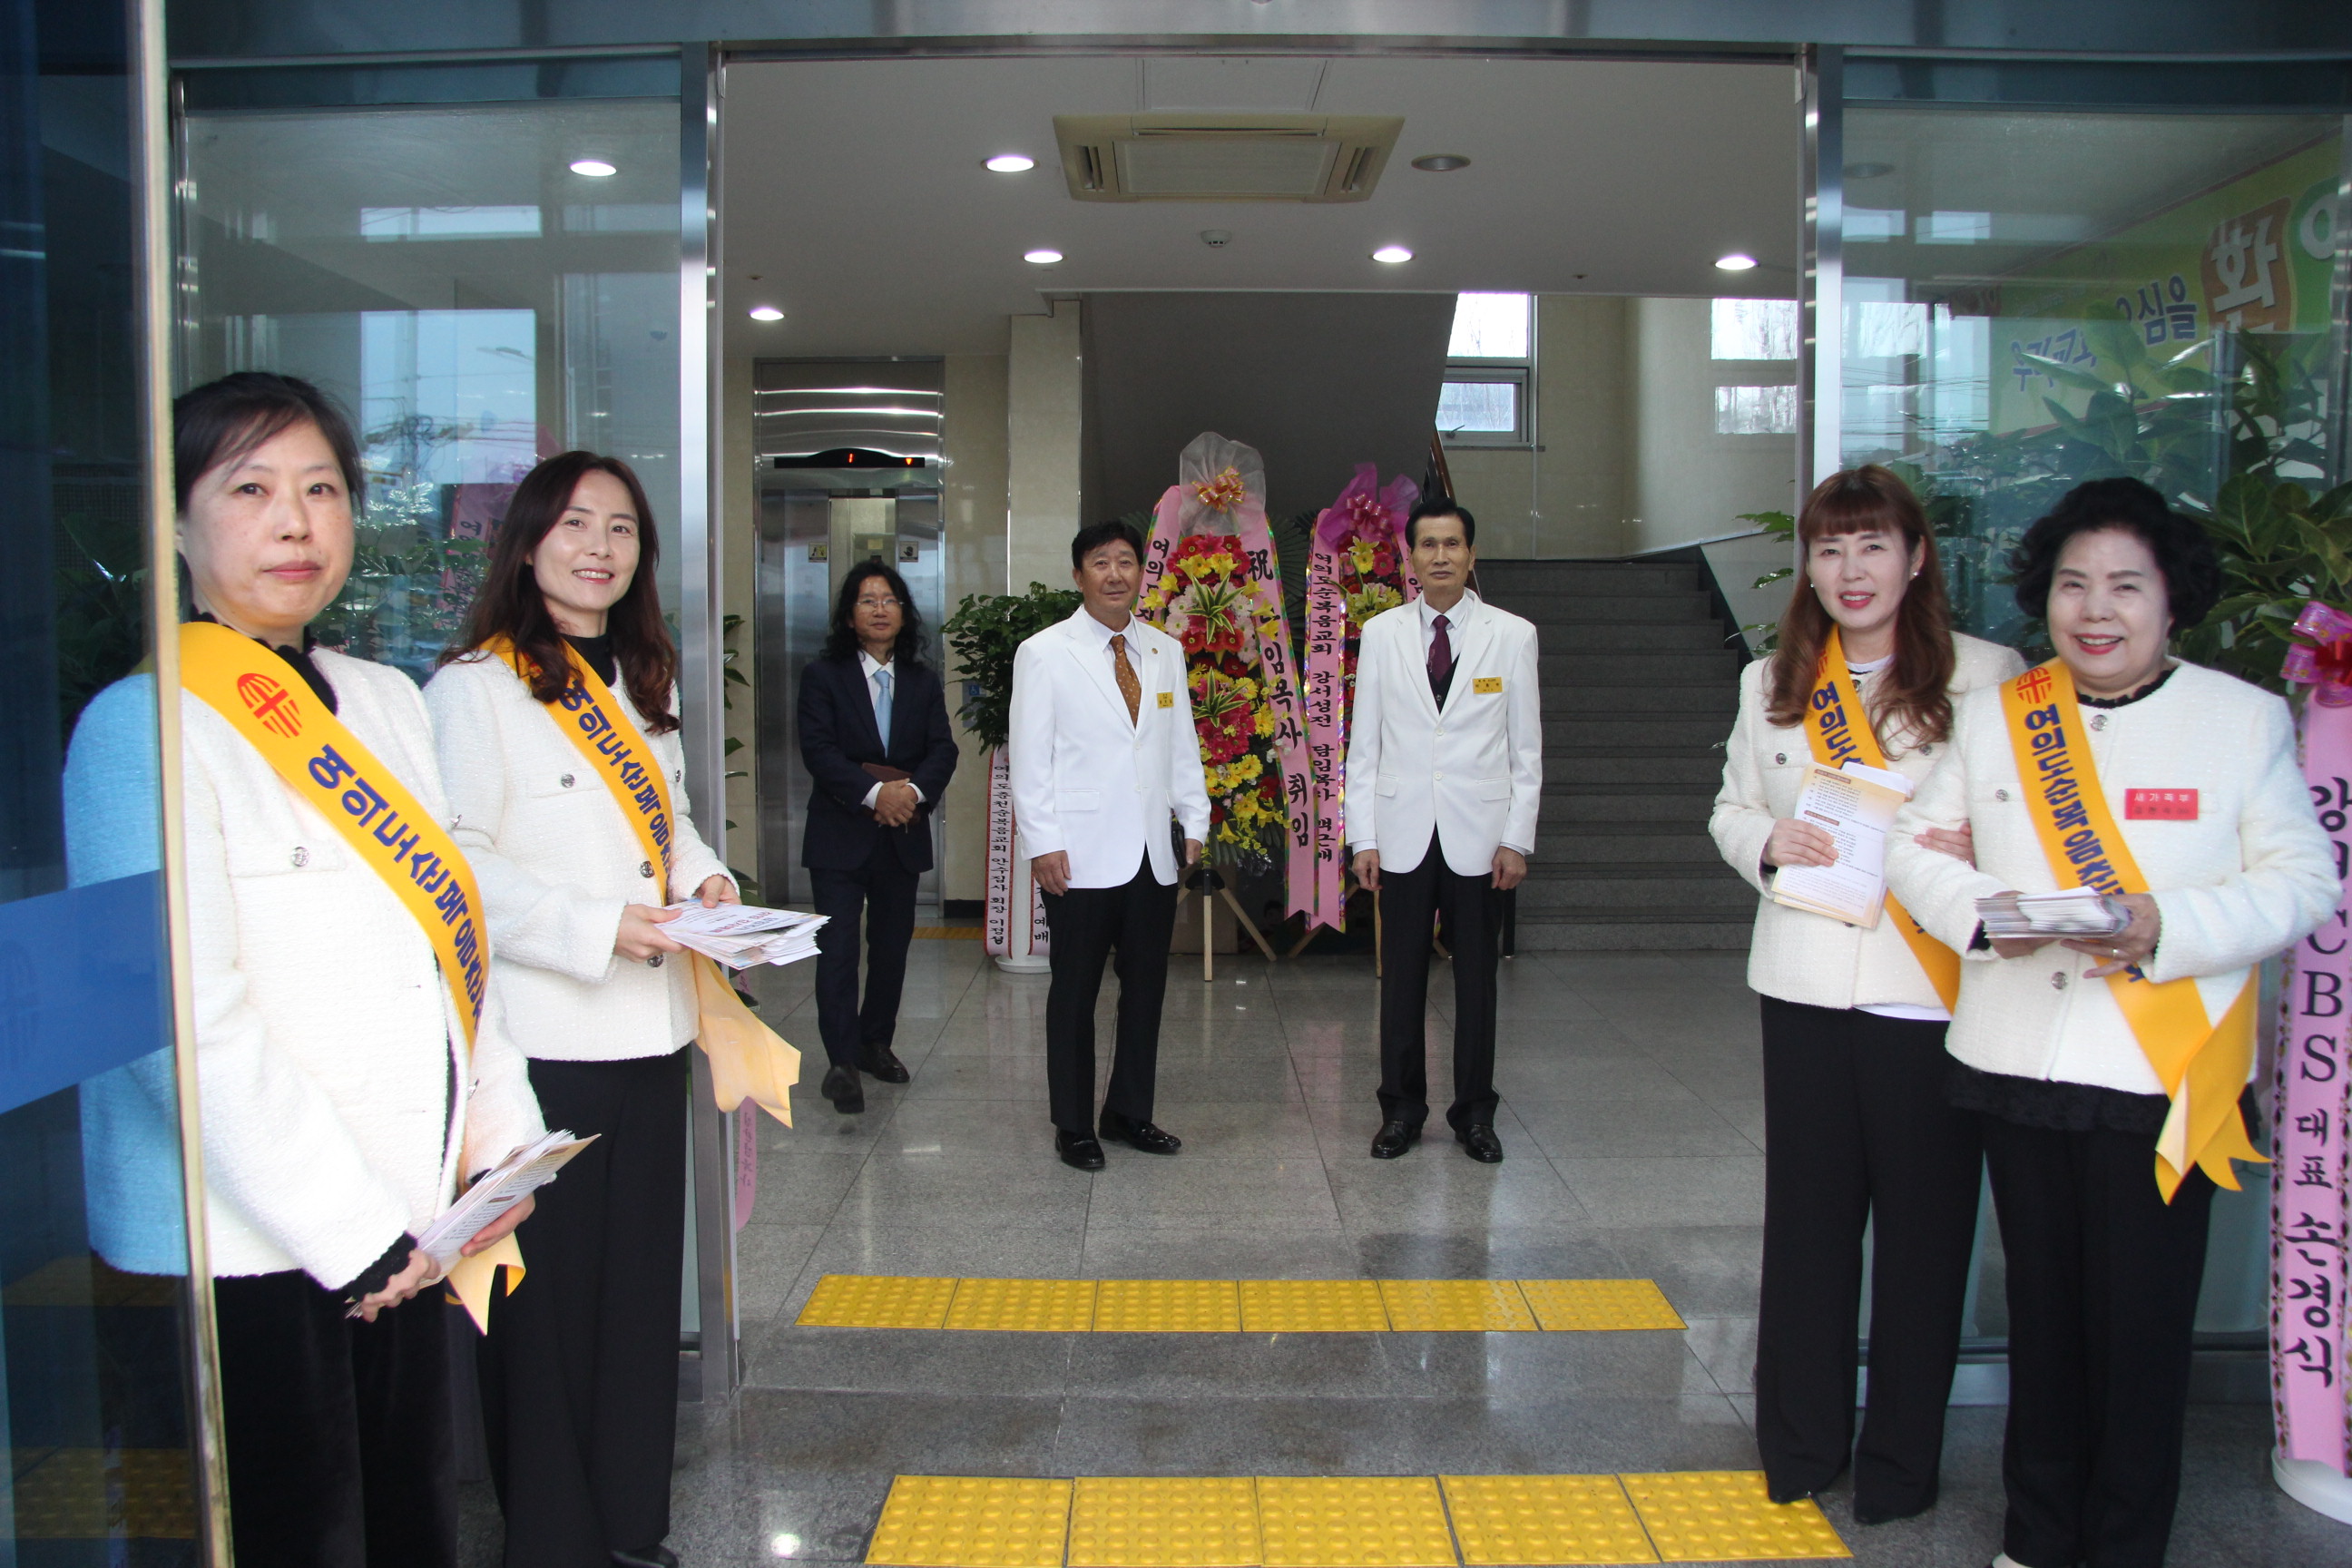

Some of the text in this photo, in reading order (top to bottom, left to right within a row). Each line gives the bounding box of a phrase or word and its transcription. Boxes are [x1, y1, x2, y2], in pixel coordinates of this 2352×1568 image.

[1310, 554, 1338, 655] 여의도순복음교회
[1247, 549, 1273, 582] 祝
[1288, 773, 1309, 848] 취임
[1308, 671, 1336, 727] 강서성전
[2293, 1108, 2332, 1189] 대표
